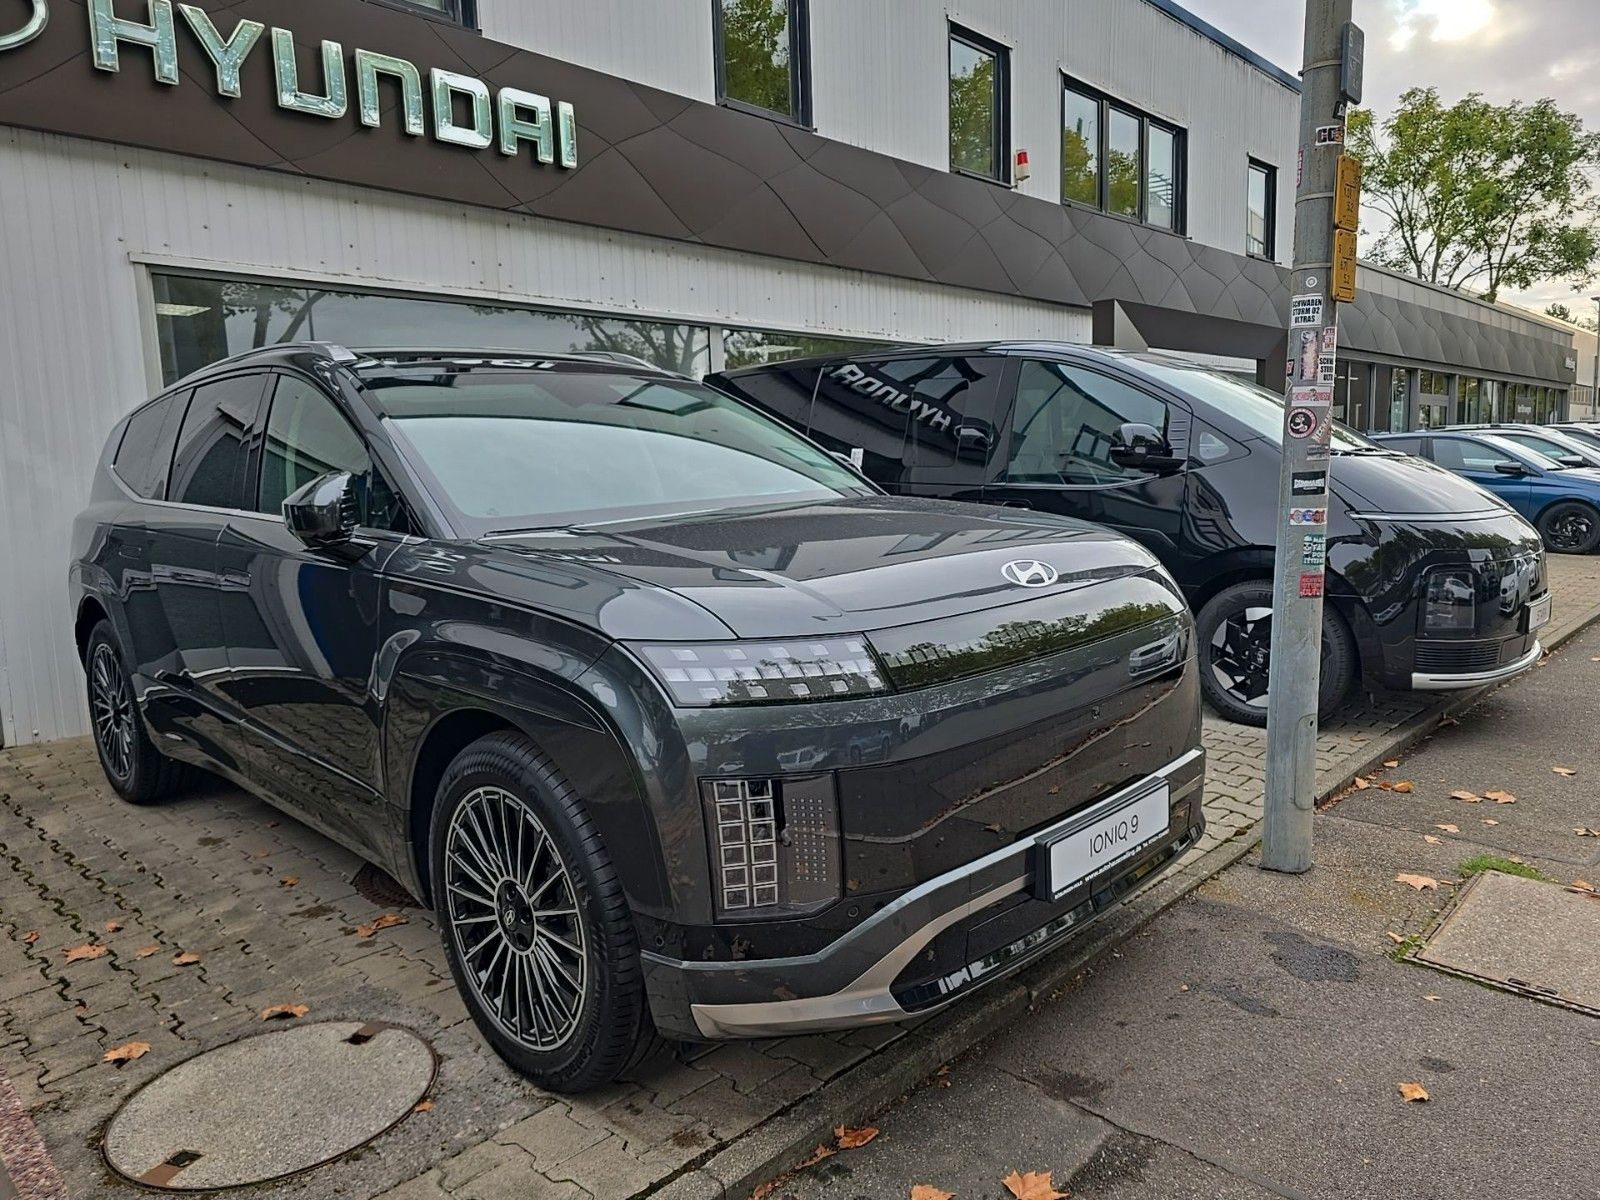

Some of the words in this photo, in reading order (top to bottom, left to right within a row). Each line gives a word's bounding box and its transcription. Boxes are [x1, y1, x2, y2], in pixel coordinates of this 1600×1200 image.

[88, 0, 578, 170] HYUNDAI
[1089, 820, 1128, 858] IONIQ
[1130, 814, 1139, 834] 9
